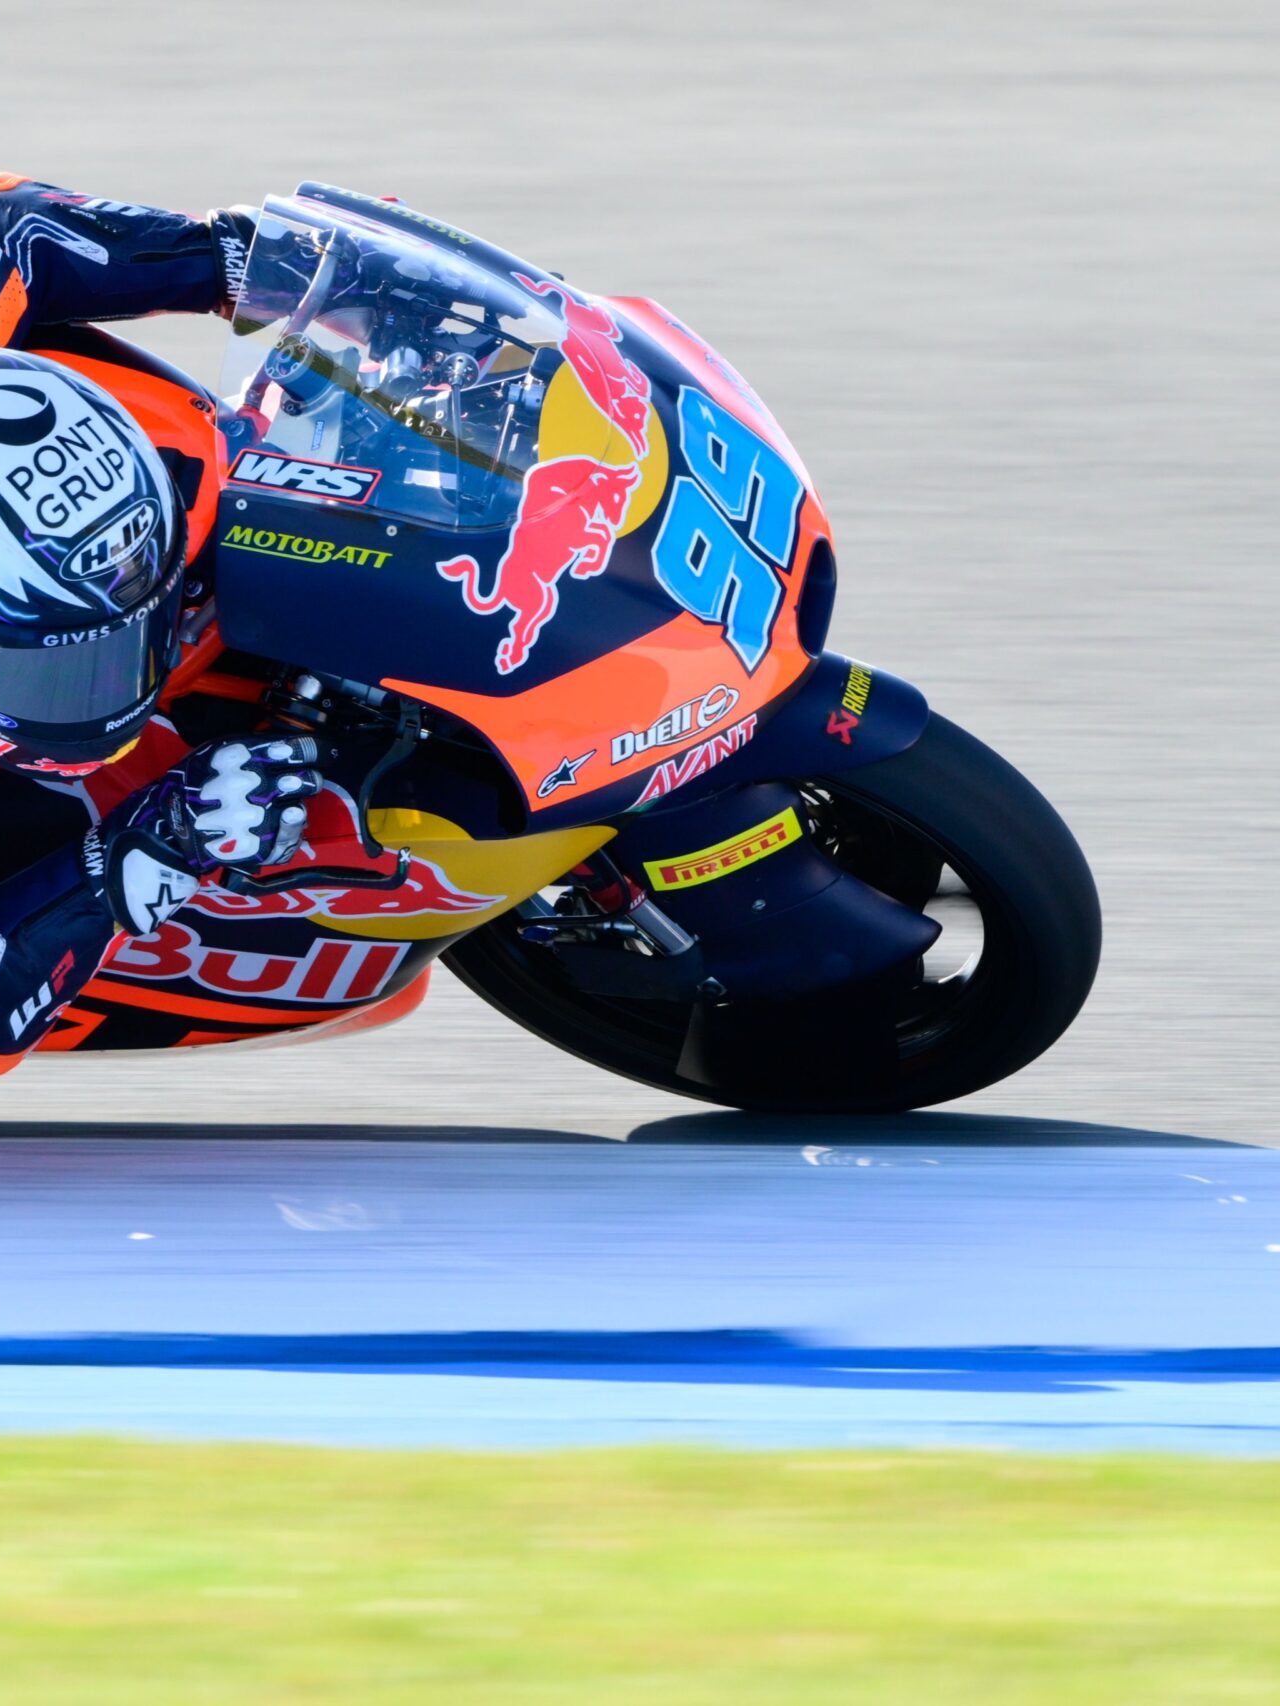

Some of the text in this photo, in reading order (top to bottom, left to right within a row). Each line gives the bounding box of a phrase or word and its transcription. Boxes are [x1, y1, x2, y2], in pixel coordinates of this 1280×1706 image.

[5, 416, 105, 502] PONT
[36, 448, 124, 529] GRUP
[233, 454, 374, 499] WRS
[80, 504, 149, 575] HJC
[222, 525, 394, 569] MOTOBATT
[651, 384, 807, 675] 99
[43, 626, 111, 647] GIVES
[625, 713, 758, 811] AVANT
[658, 821, 788, 885] PIRELLI
[101, 921, 412, 1003] Bull
